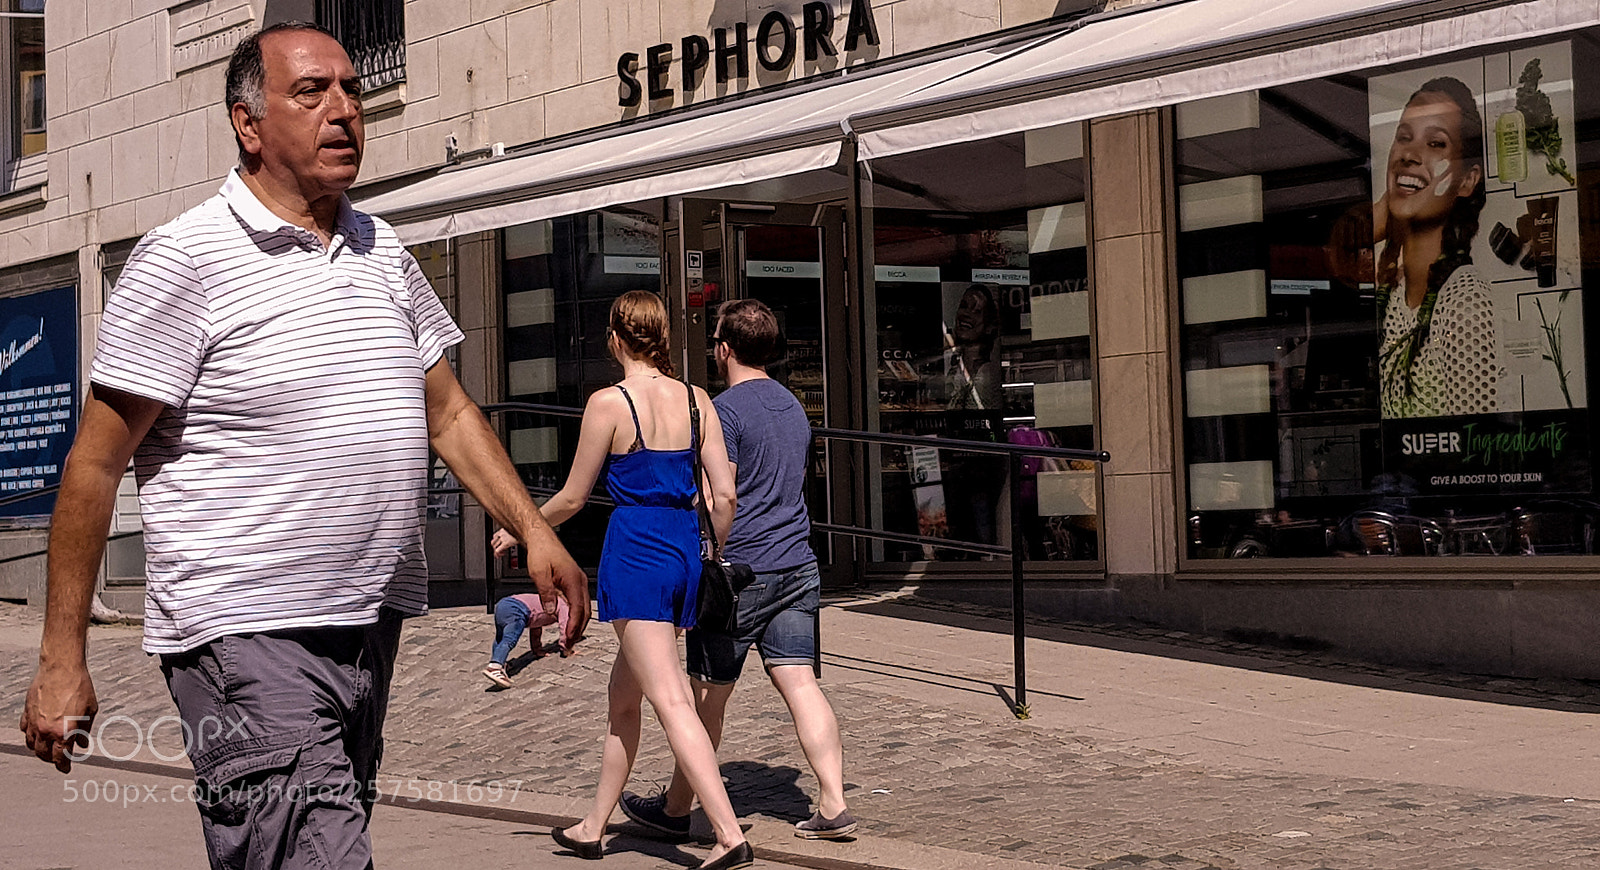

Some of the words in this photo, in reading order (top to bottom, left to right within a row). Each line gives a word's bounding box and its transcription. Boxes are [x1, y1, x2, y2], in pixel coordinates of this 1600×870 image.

[618, 0, 880, 107] SEPHORA
[1401, 431, 1461, 455] SUPER
[1462, 419, 1568, 466] Ingredients
[1430, 475, 1450, 486] GIVE
[1450, 475, 1458, 485] A
[1459, 474, 1486, 484] BOOST
[1487, 474, 1498, 484] TO
[1499, 472, 1521, 483] YOUR
[1522, 472, 1542, 482] SKIN
